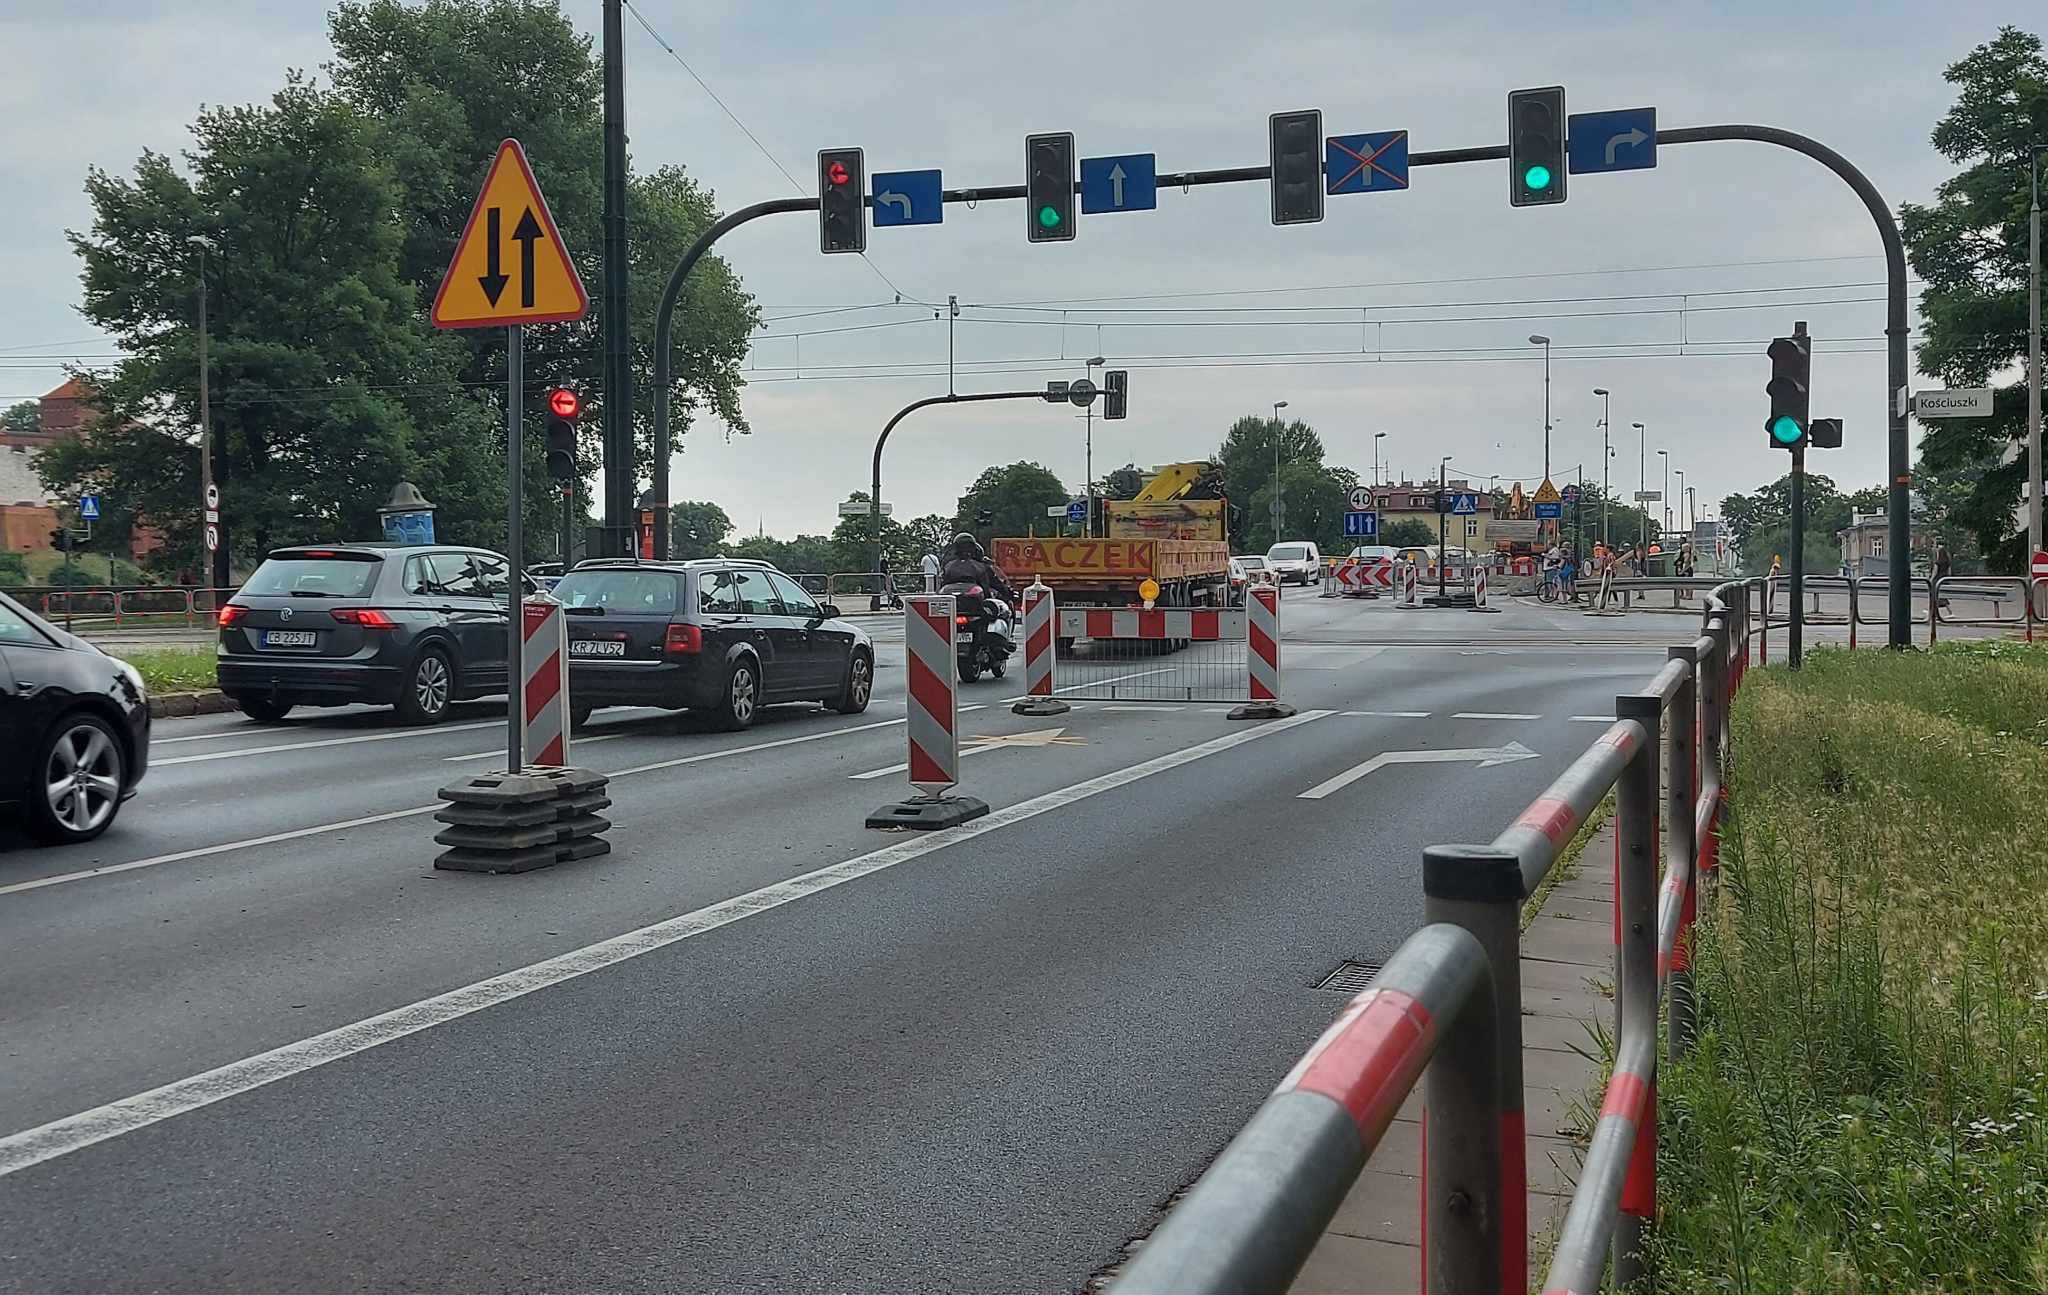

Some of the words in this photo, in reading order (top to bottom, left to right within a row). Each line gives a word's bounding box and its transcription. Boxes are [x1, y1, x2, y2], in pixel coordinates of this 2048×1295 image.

[1920, 397, 1978, 408] Kościuszki
[1352, 493, 1370, 505] 40
[1000, 542, 1153, 569] RACZEK
[269, 632, 280, 643] CB
[574, 642, 587, 653] KR
